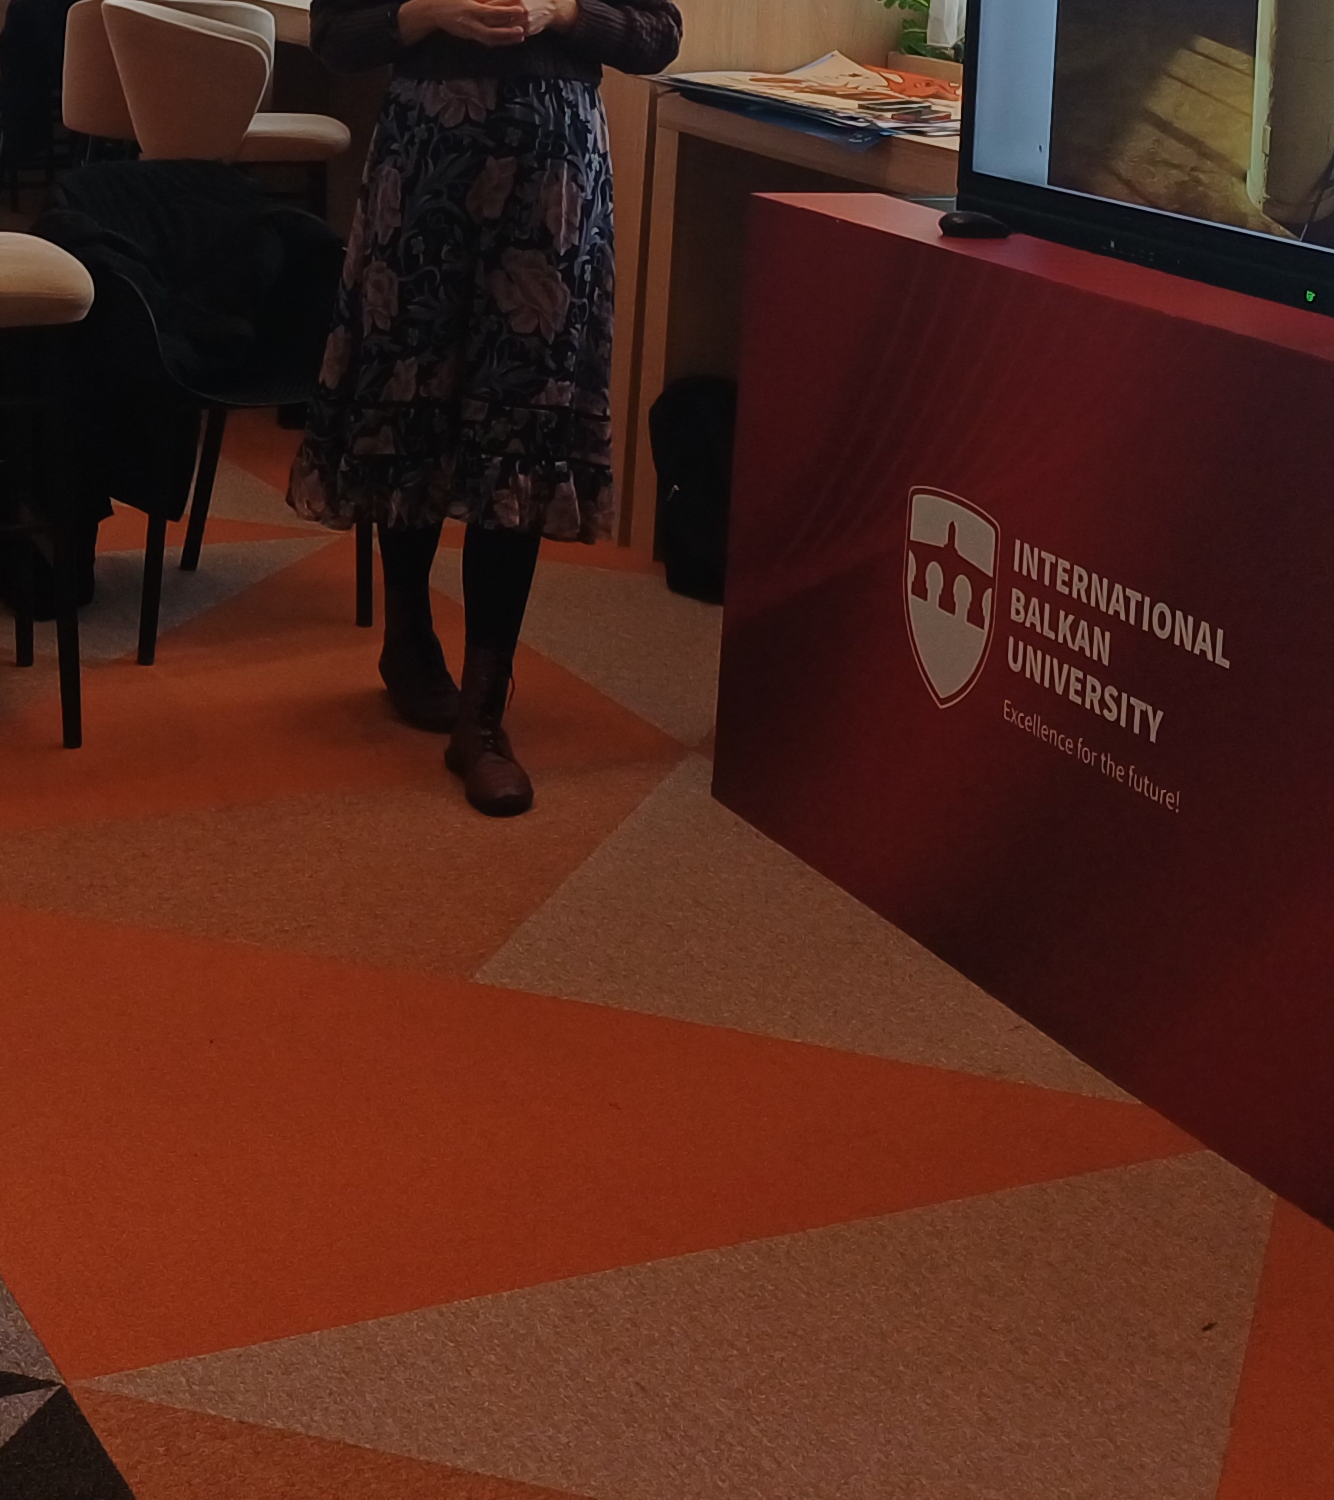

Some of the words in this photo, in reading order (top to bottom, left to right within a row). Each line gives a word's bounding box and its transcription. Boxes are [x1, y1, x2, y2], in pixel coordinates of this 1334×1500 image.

[1010, 587, 1111, 666] BALKAN
[1012, 538, 1231, 669] INTERNATIONAL
[1007, 636, 1165, 744] UNIVERSITY
[1003, 699, 1074, 755] Excellence
[1077, 736, 1098, 768] for
[1100, 752, 1125, 784] the
[1128, 765, 1181, 814] future!
